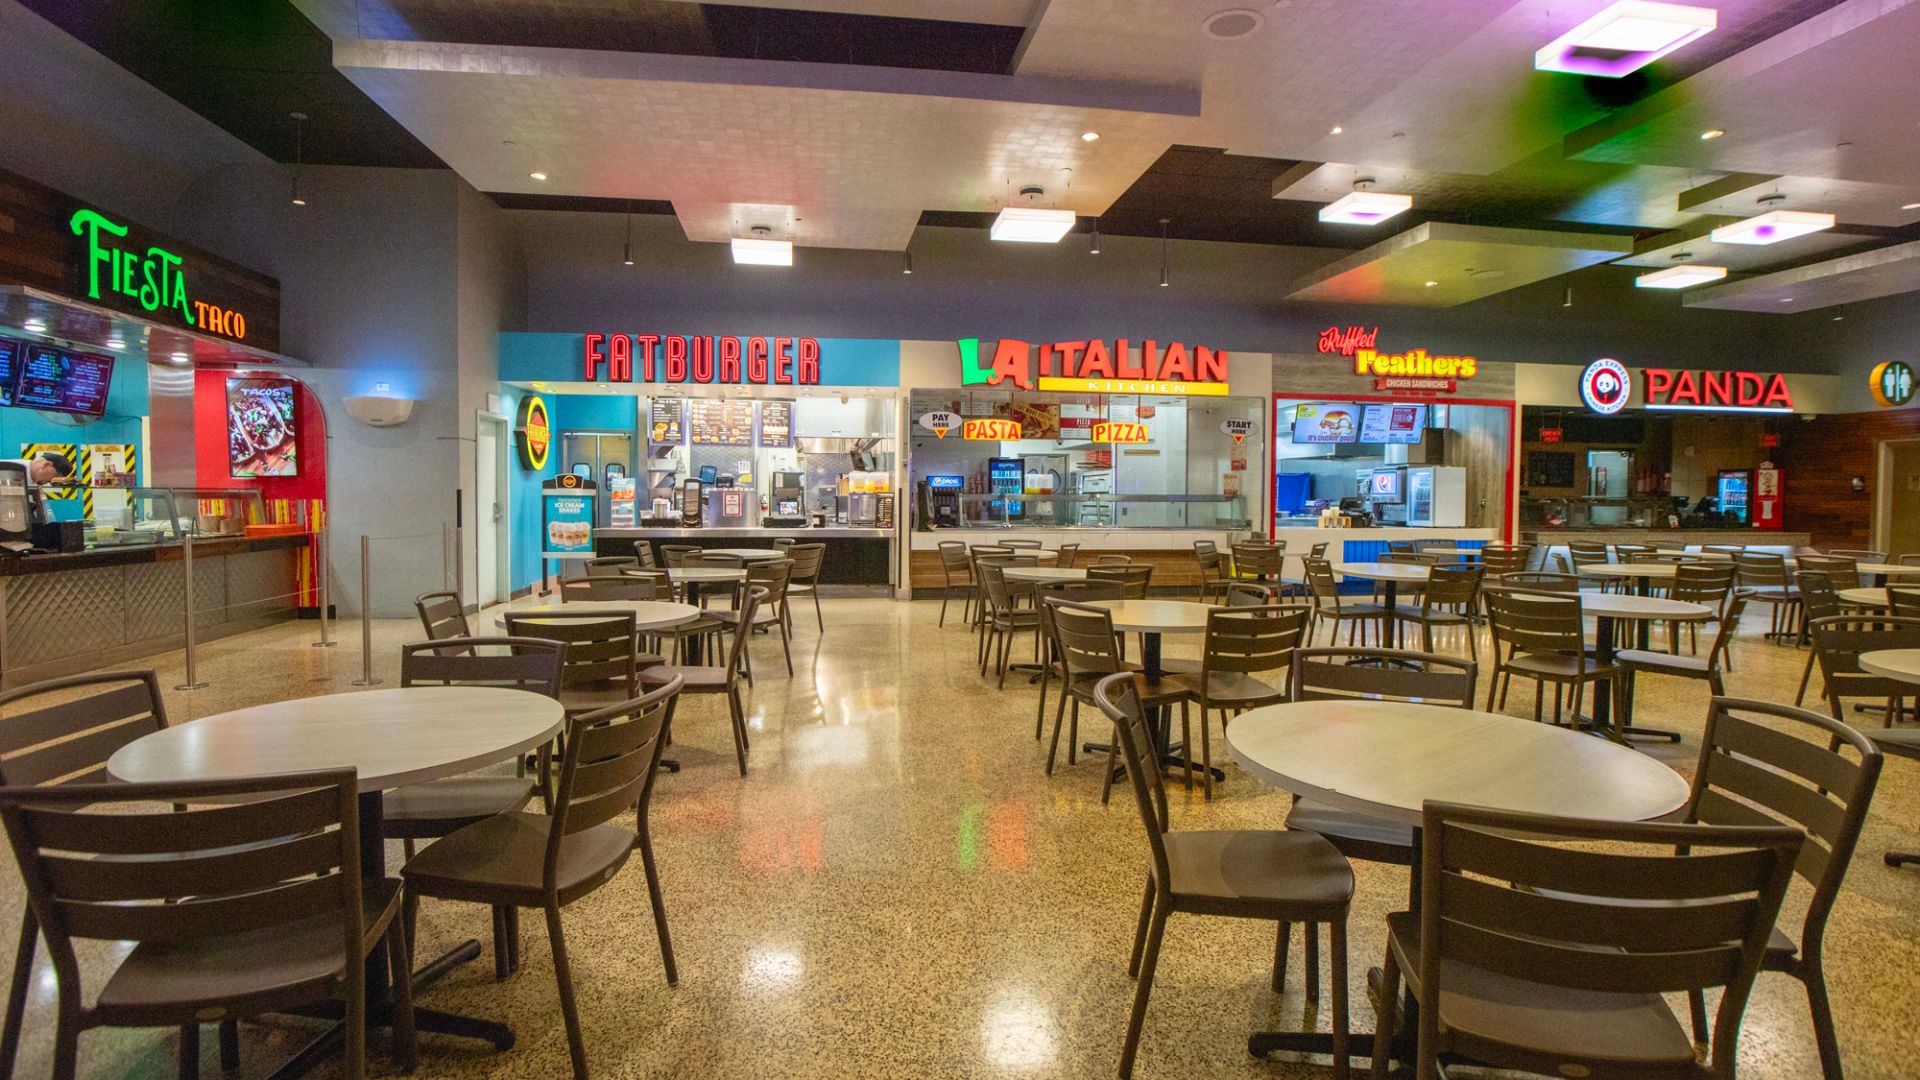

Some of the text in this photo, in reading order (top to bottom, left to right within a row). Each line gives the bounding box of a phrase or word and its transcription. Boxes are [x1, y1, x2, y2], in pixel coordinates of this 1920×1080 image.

[71, 209, 194, 325] FIESTA
[195, 301, 246, 339] TACO
[1318, 326, 1378, 356] Ruffled
[585, 333, 820, 385] FATBURGER
[958, 338, 1228, 390] LA ITALIAN
[1355, 349, 1478, 377] Feathers
[1386, 379, 1449, 389] CHICKEN SANDWICHES
[1586, 361, 1628, 385] PANDA EXPRESS
[240, 388, 281, 396] TACOS
[1088, 381, 1187, 393] KITCHEN
[1644, 368, 1793, 406] PANDA
[966, 421, 1019, 439] PASTA
[1095, 424, 1147, 441] PIZZA
[1227, 421, 1251, 429] START
